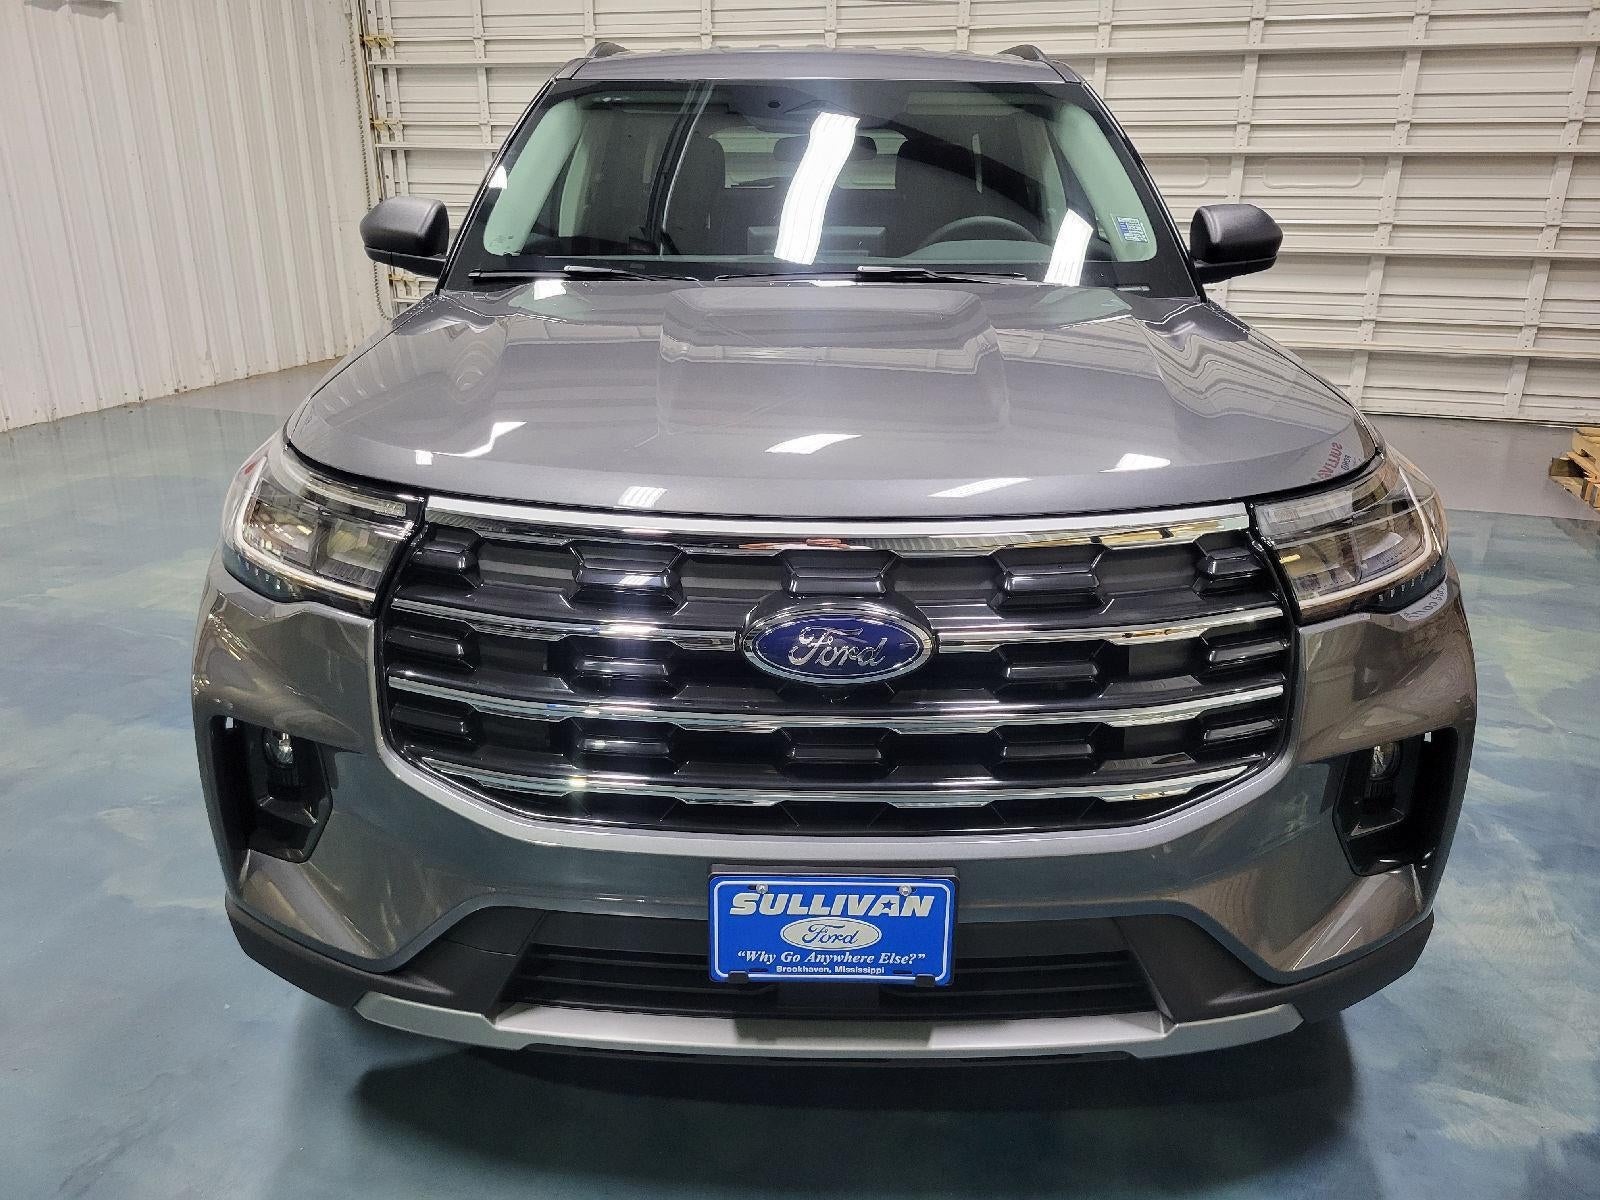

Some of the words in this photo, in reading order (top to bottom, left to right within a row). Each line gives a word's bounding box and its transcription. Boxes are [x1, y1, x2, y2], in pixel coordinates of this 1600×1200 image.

[787, 626, 888, 667] Ford
[729, 892, 935, 917] SULLIVAN
[801, 923, 859, 945] Ford
[737, 950, 776, 965] “Why
[781, 951, 801, 963] Go
[804, 952, 875, 965] Anywhere
[878, 953, 926, 965] Else?”
[776, 965, 832, 974] Brookhaven,
[834, 966, 885, 975] Mississippi
